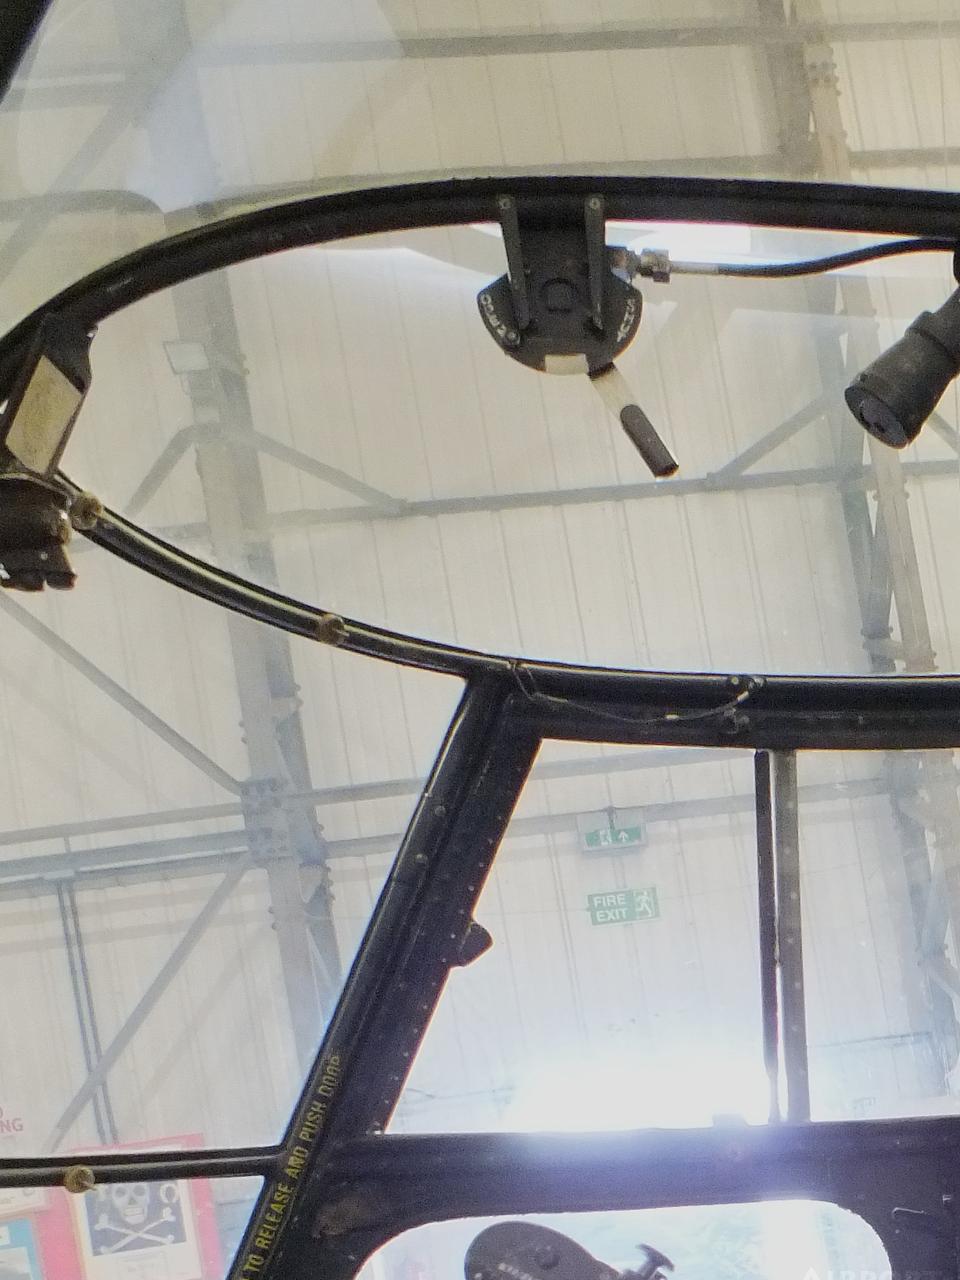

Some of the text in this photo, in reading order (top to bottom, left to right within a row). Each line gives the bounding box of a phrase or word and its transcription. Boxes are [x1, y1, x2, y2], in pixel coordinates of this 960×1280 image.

[593, 893, 627, 908] FIRE
[595, 907, 629, 922] EXIT
[243, 1253, 265, 1273] TO
[284, 1145, 309, 1180] AND
[299, 1100, 328, 1142] PUSH
